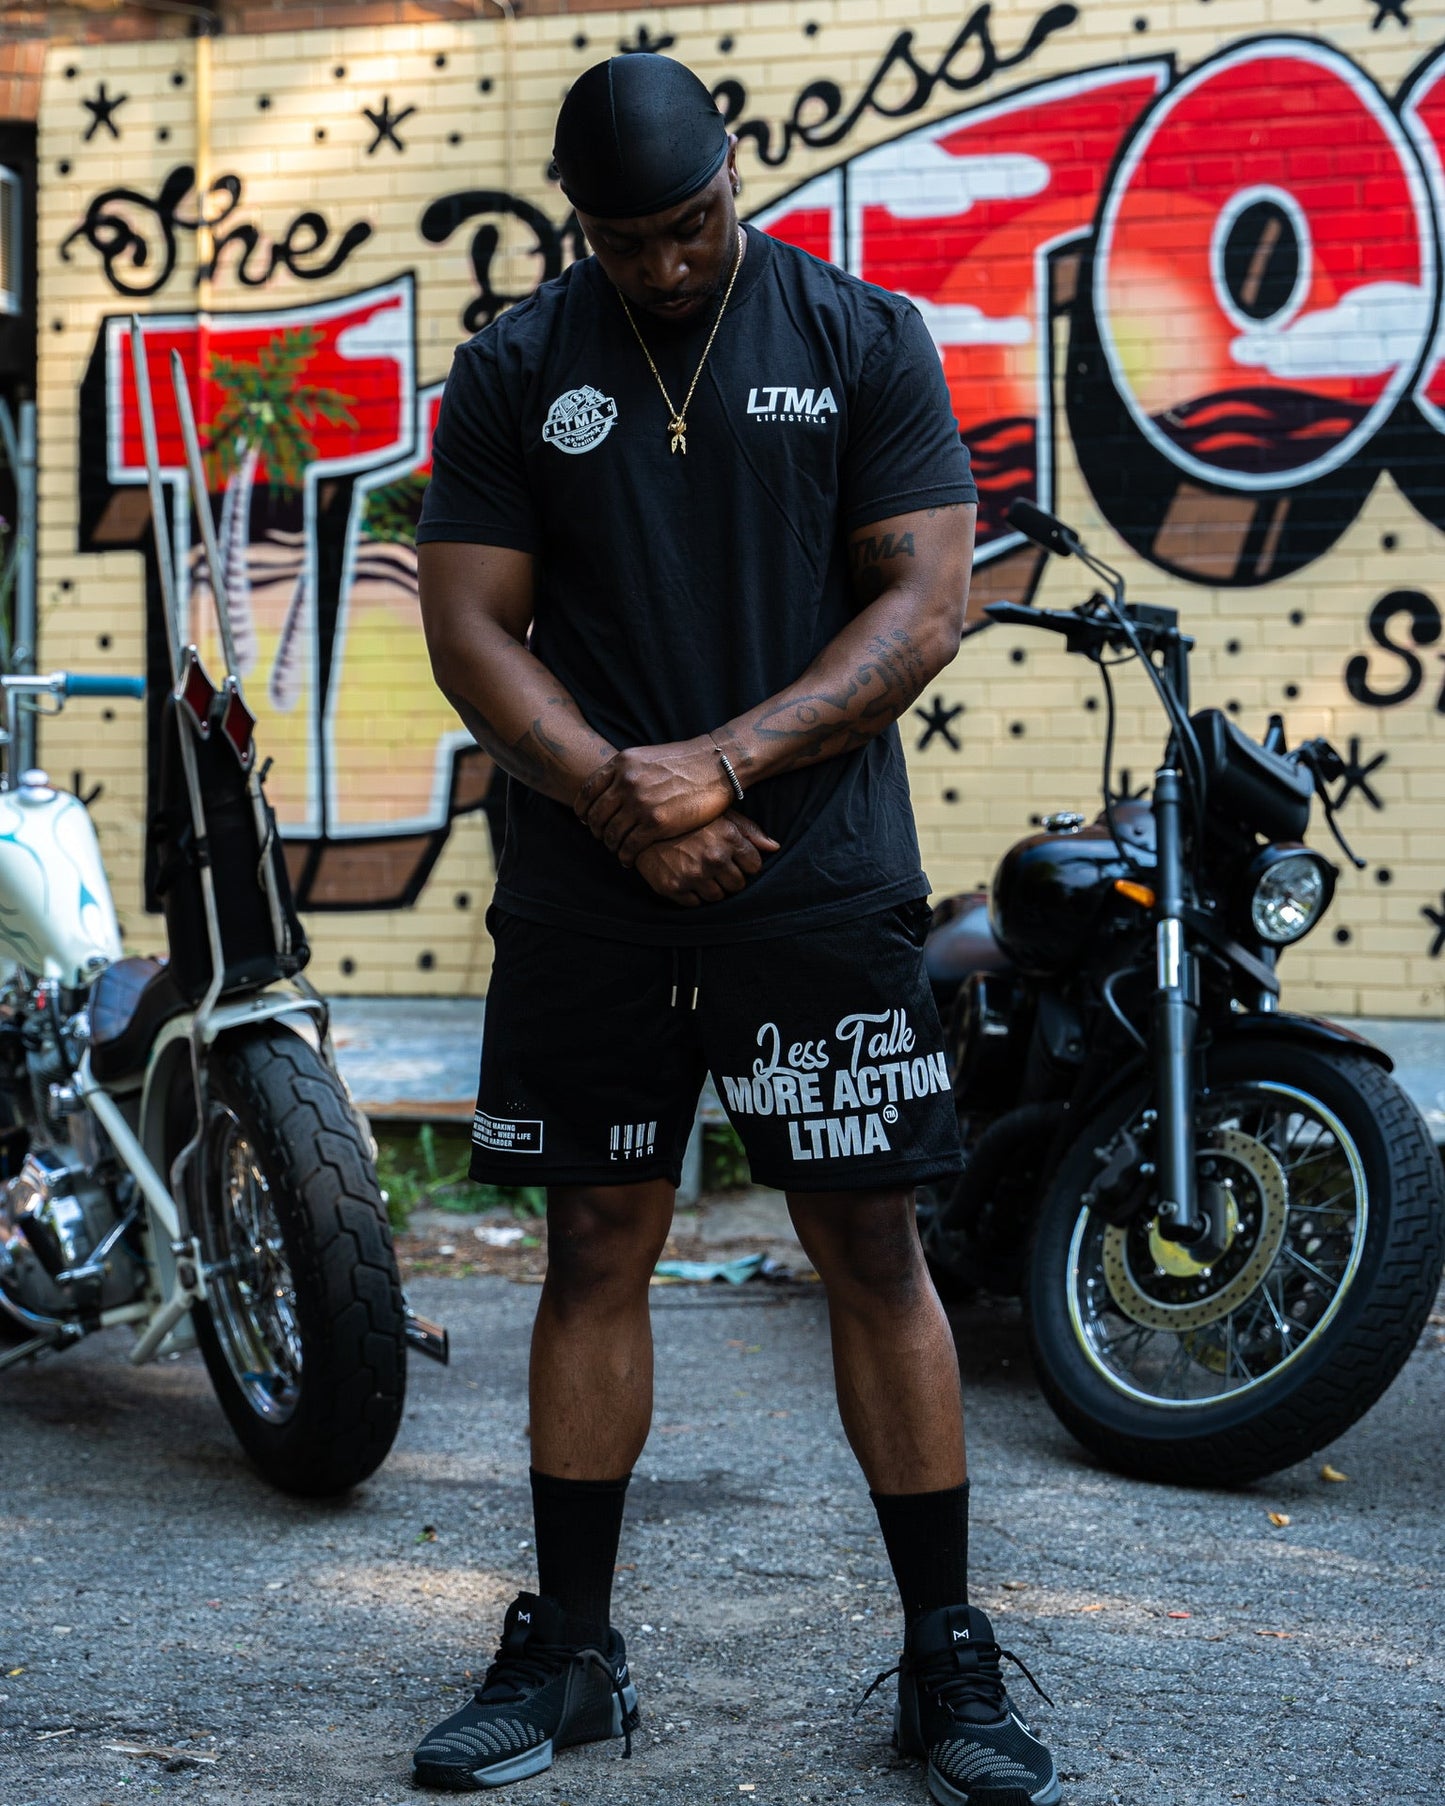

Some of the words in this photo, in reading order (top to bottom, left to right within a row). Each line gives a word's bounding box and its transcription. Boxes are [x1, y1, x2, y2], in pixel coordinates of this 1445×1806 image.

[60, 166, 373, 297] The
[747, 386, 838, 415] LTMA
[553, 408, 604, 435] LTMA
[756, 414, 827, 424] LIFESTYLE
[851, 532, 916, 564] TMA
[753, 1022, 830, 1079] Less
[836, 1008, 916, 1078] Talk
[722, 1072, 824, 1116] MORE
[833, 1051, 951, 1111] ACTION
[493, 1122, 515, 1131] MAKING
[497, 1131, 516, 1140] WHEN
[517, 1132, 532, 1141] LIFE
[788, 1113, 891, 1161] LTMA
[610, 1145, 654, 1160] LTMA
